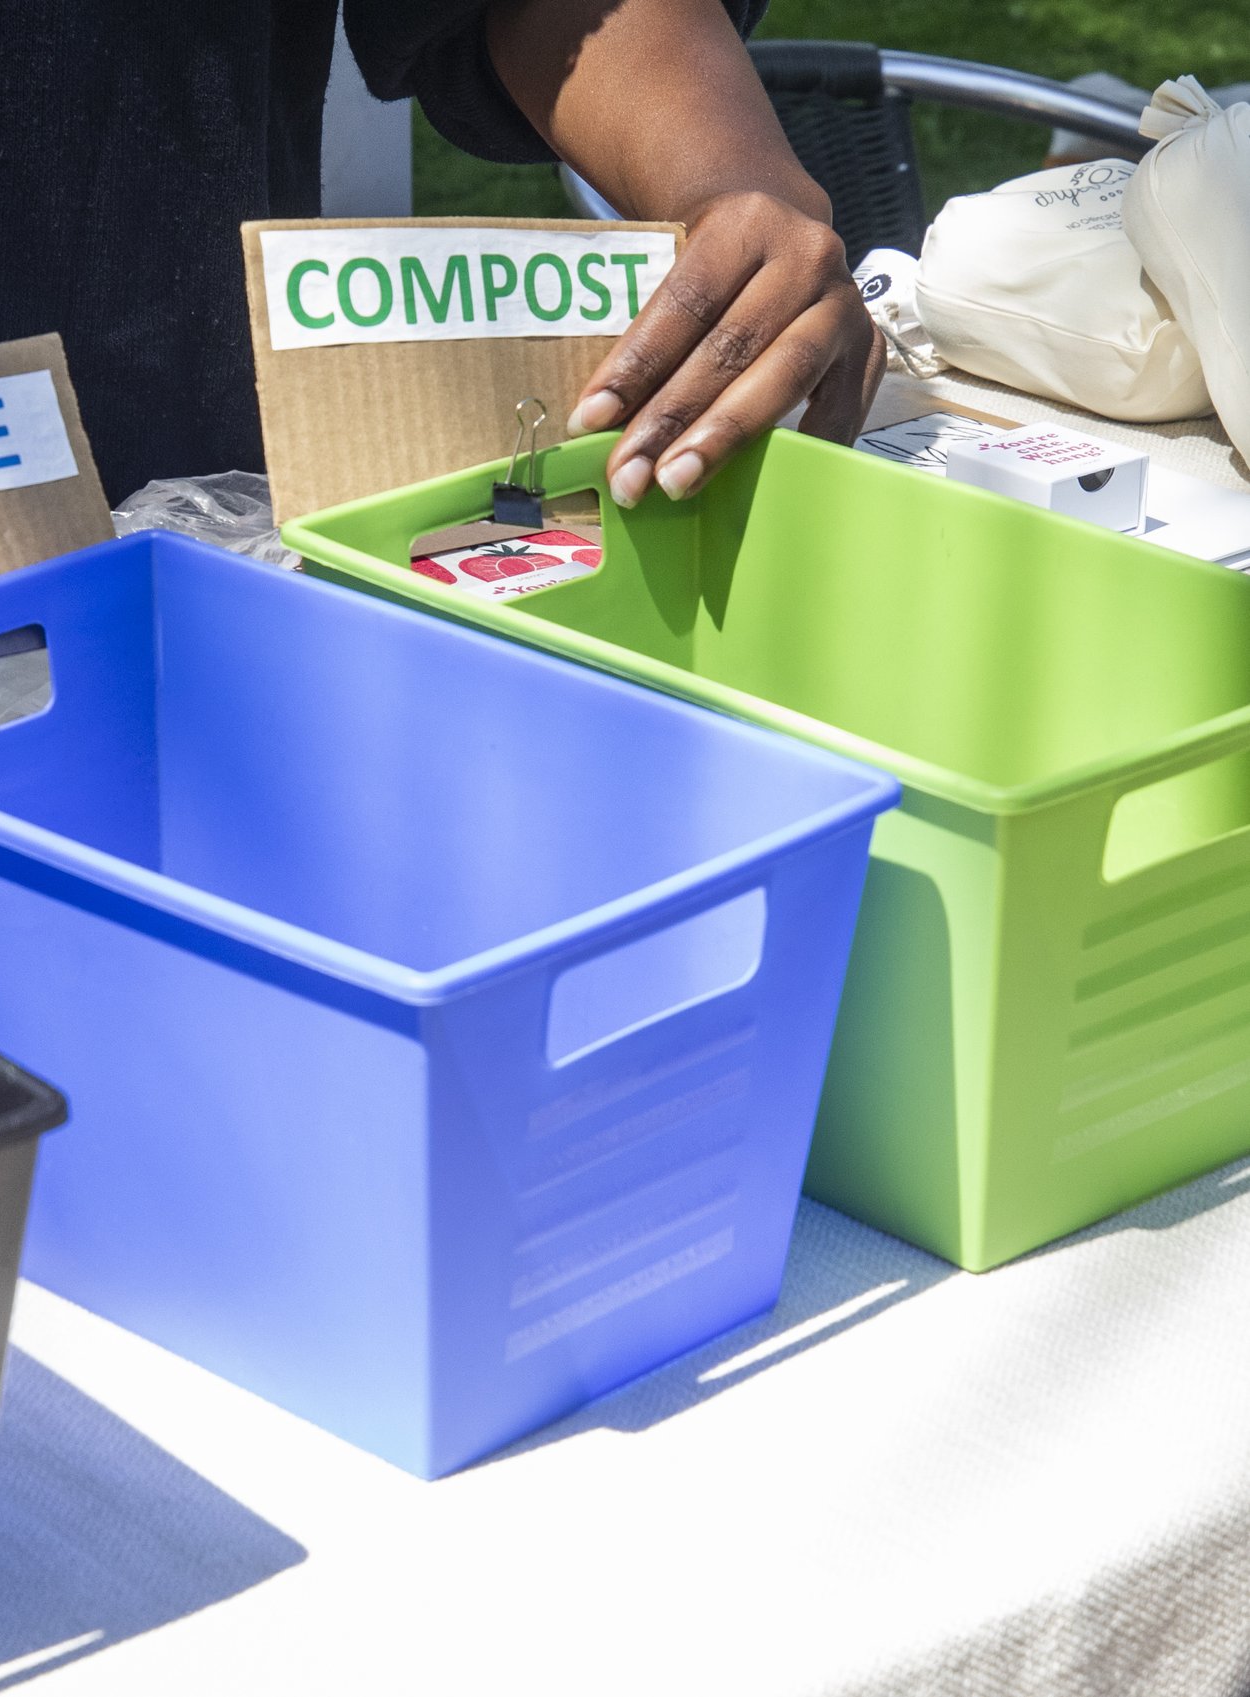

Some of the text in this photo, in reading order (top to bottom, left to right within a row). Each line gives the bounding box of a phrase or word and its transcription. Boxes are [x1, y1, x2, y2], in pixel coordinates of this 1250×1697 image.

[286, 253, 649, 329] COMPOST
[991, 433, 1059, 450] You're
[1017, 440, 1069, 454] cute.
[1019, 442, 1092, 461] Wanna
[1042, 446, 1105, 465] hang?
